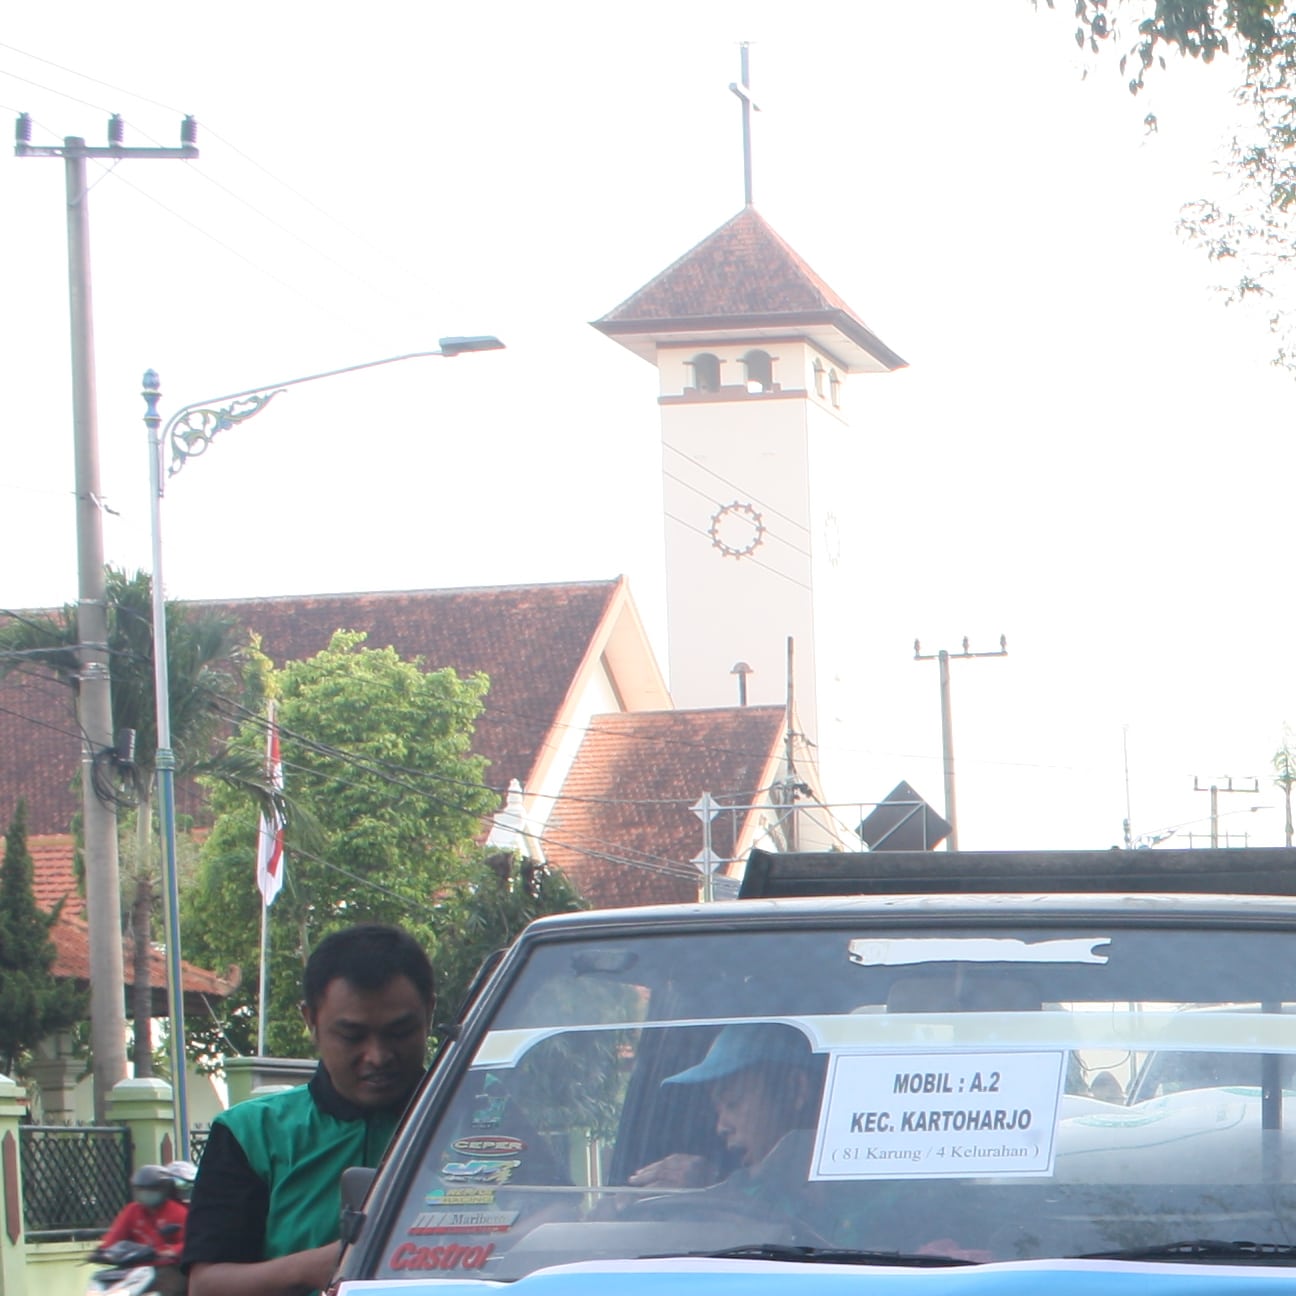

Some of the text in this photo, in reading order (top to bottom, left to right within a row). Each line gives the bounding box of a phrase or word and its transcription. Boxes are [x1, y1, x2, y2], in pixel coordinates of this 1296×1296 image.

[893, 1073, 953, 1094] MOBIL
[970, 1071, 1000, 1093] A.2
[850, 1109, 1032, 1133] KEC. KARTOHARJO
[453, 1141, 523, 1151] CEPER
[842, 1147, 859, 1160] 81
[866, 1146, 921, 1162] Karung
[936, 1146, 945, 1159] 4
[951, 1144, 1029, 1159] Kelurahan
[452, 1214, 507, 1226] Marlbo
[389, 1242, 496, 1271] Castrol
